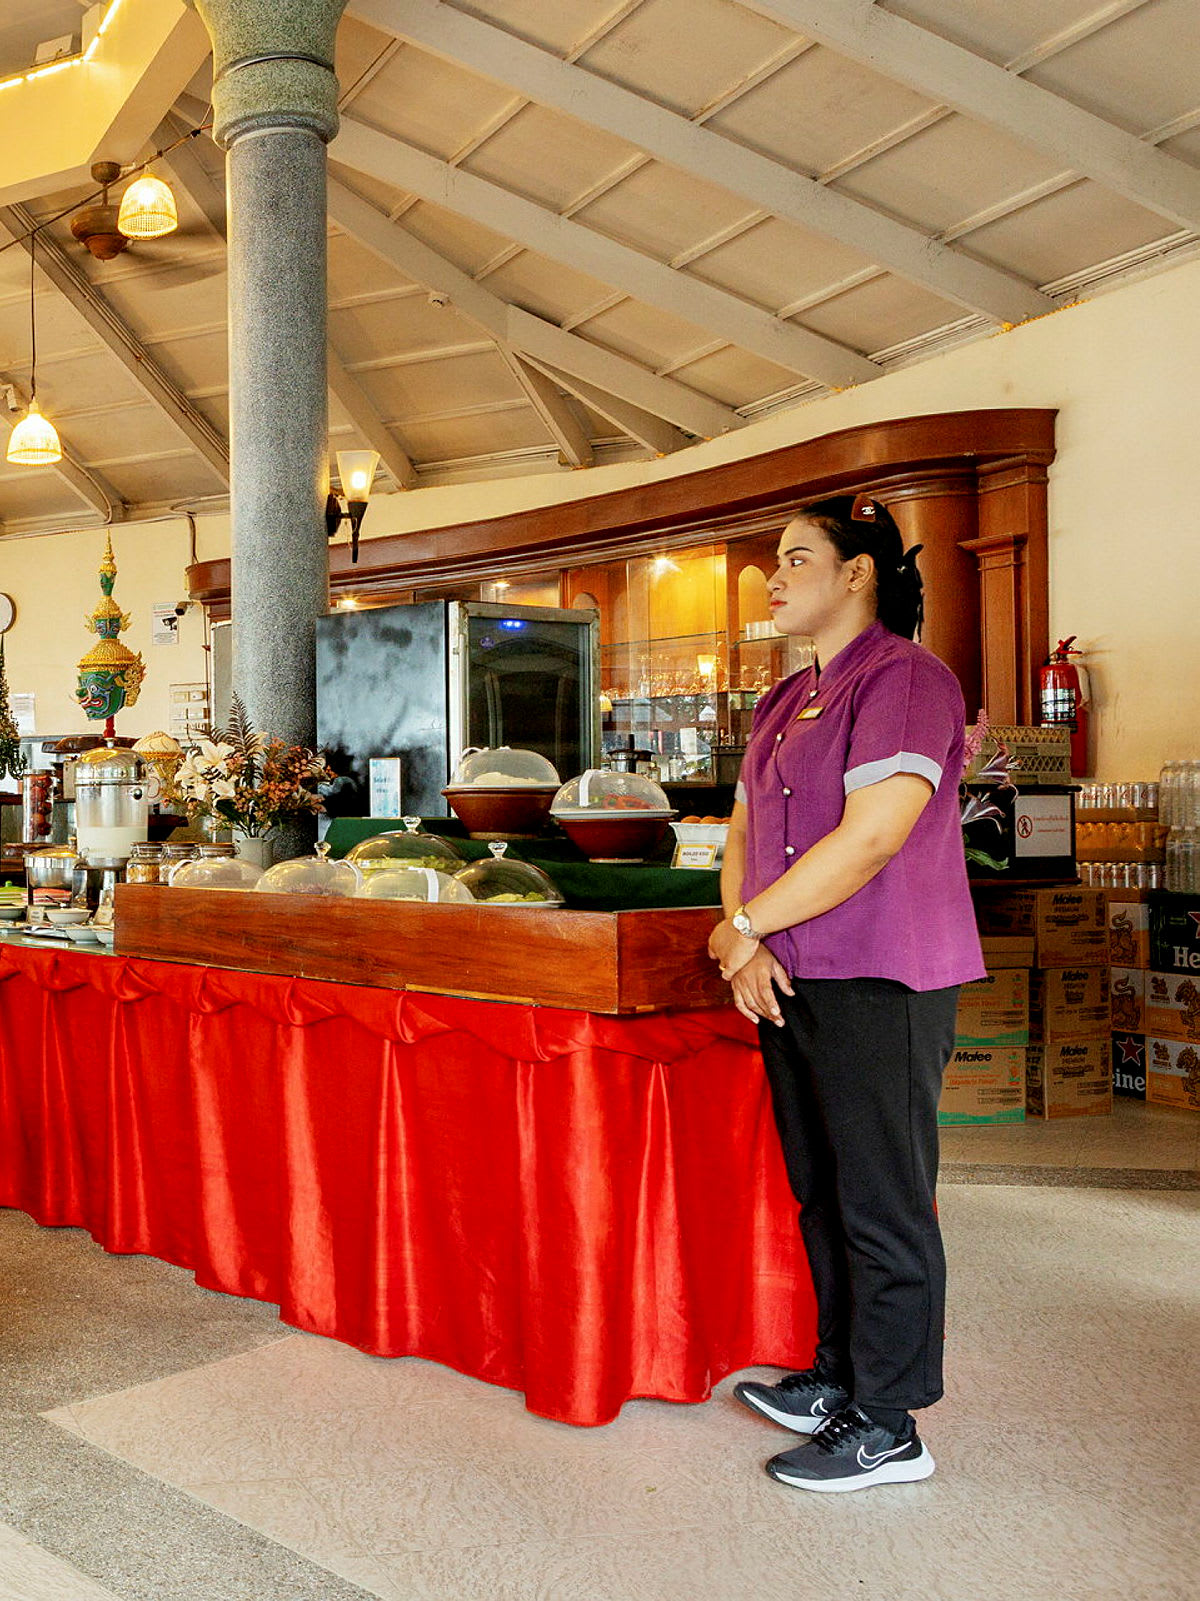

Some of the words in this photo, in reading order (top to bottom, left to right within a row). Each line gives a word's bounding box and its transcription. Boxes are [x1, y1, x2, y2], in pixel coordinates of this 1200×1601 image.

[1052, 893, 1083, 906] Malee
[1172, 945, 1200, 969] He
[954, 1051, 993, 1063] Malee
[1112, 1068, 1146, 1092] ine
